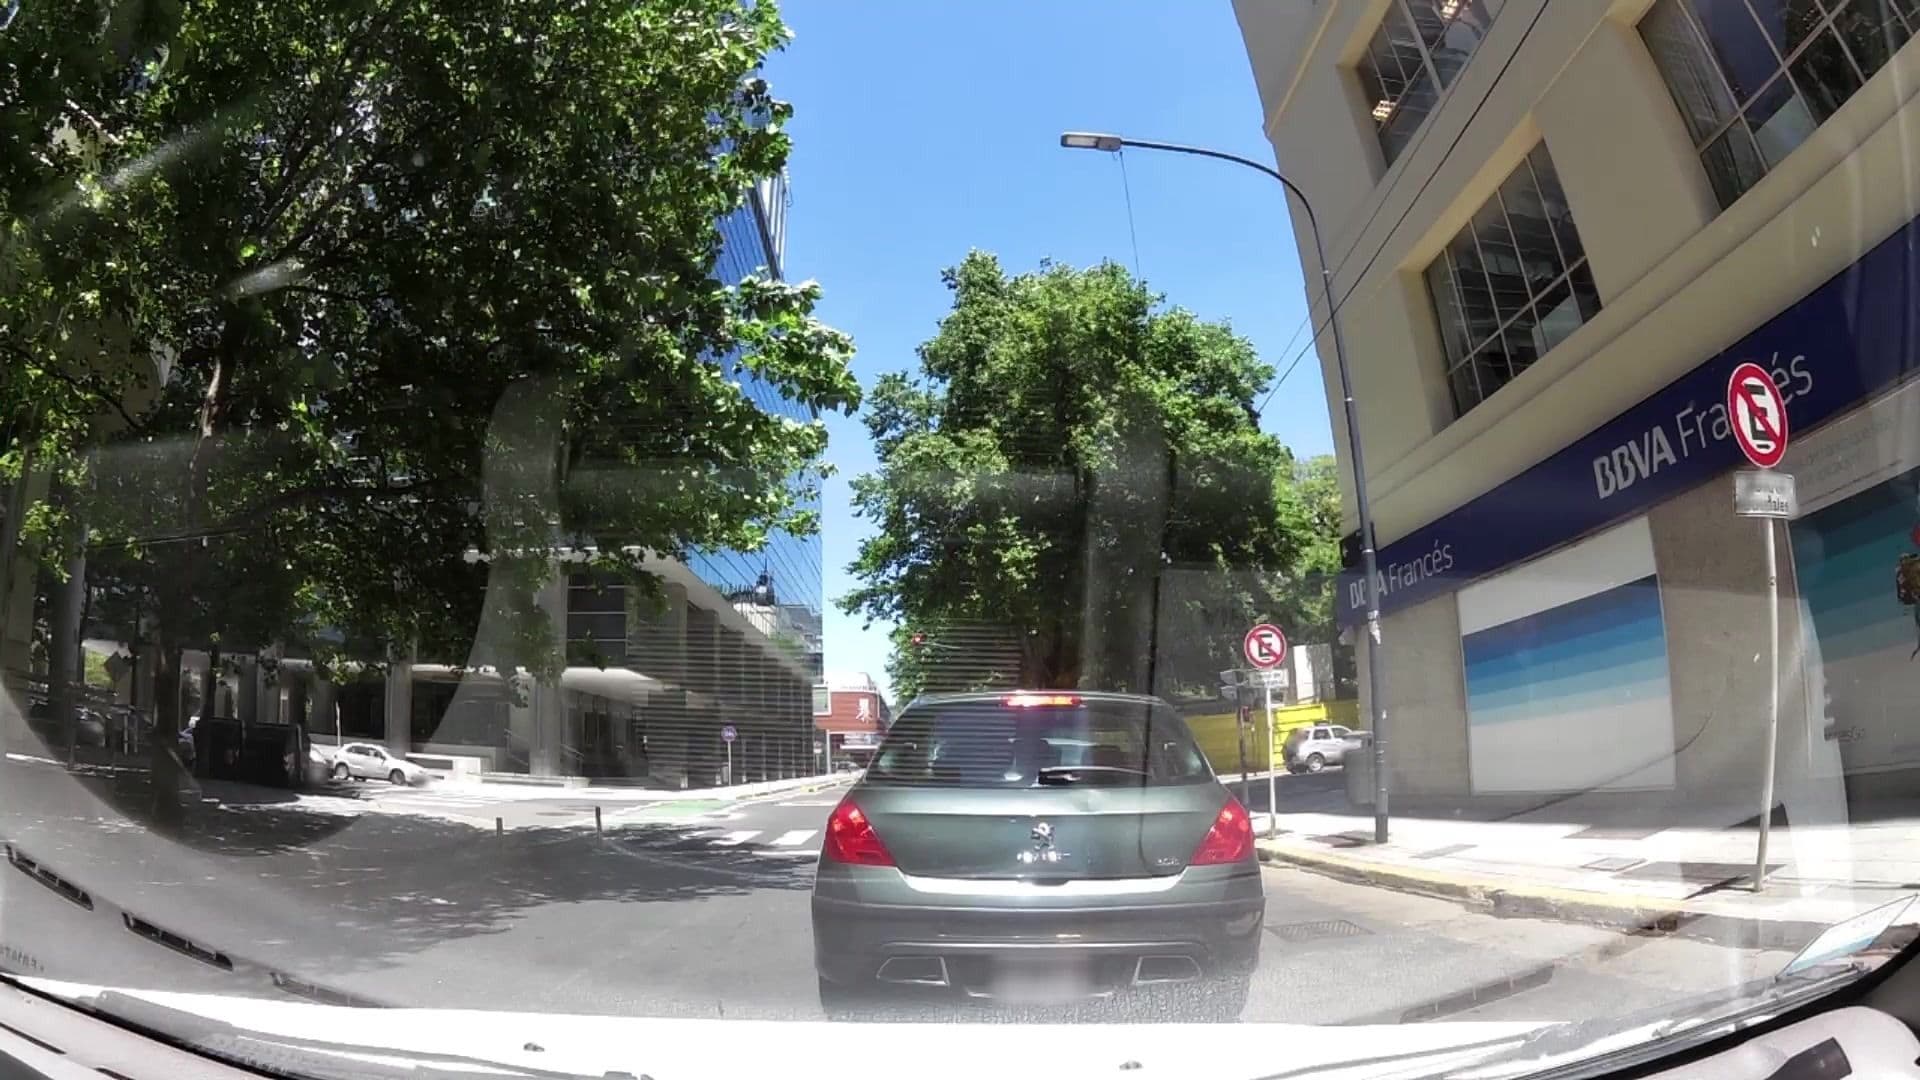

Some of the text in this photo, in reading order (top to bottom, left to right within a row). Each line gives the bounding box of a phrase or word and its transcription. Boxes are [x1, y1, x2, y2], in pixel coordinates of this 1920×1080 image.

[1593, 425, 1677, 499] BBVA
[1675, 352, 1813, 457] Fraés
[1389, 539, 1454, 593] Francés
